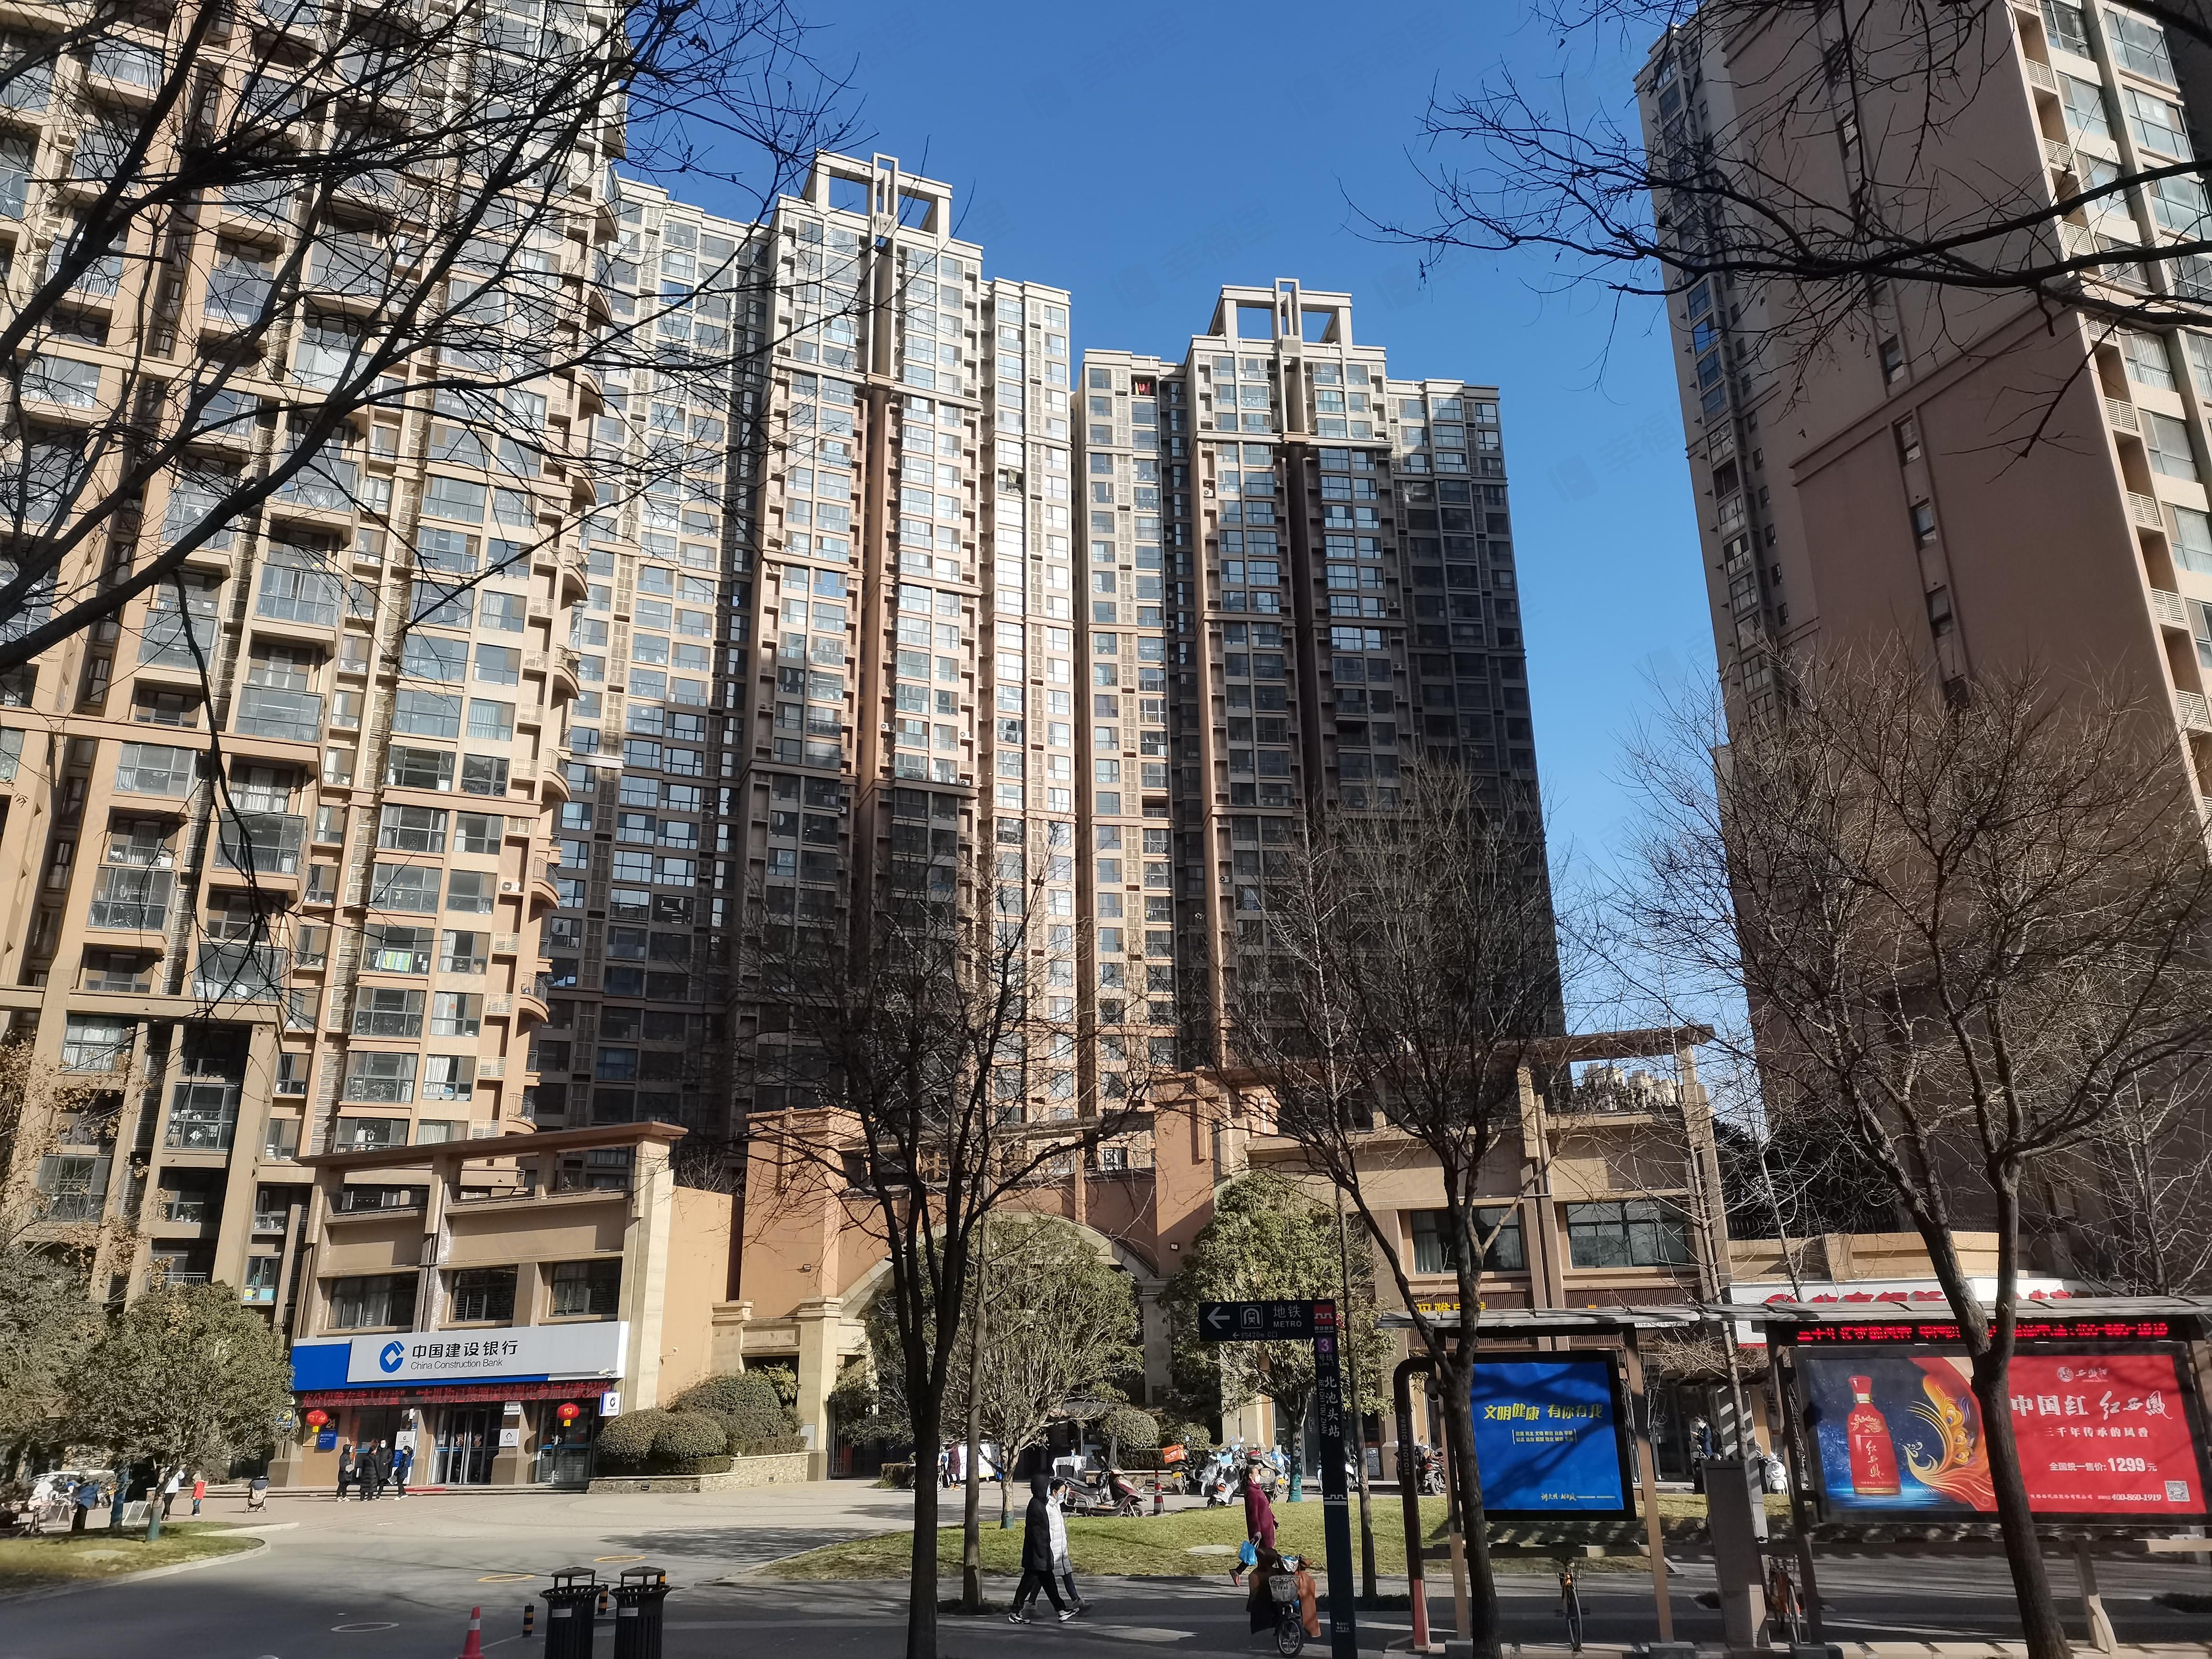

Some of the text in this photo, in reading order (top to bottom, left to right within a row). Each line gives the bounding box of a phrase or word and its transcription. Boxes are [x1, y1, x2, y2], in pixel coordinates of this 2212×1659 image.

[1273, 1305, 1301, 1318] 地铁
[412, 1340, 518, 1358] 中国建设银行
[1321, 1338, 1329, 1352] 3
[411, 1358, 503, 1370] China Construction Bank
[1319, 1354, 1333, 1362] 号线
[1325, 1376, 1340, 1437] 北池头站
[1484, 1403, 1603, 1421] 文明健康 有你有我
[2010, 1395, 2089, 1416] 中国红
